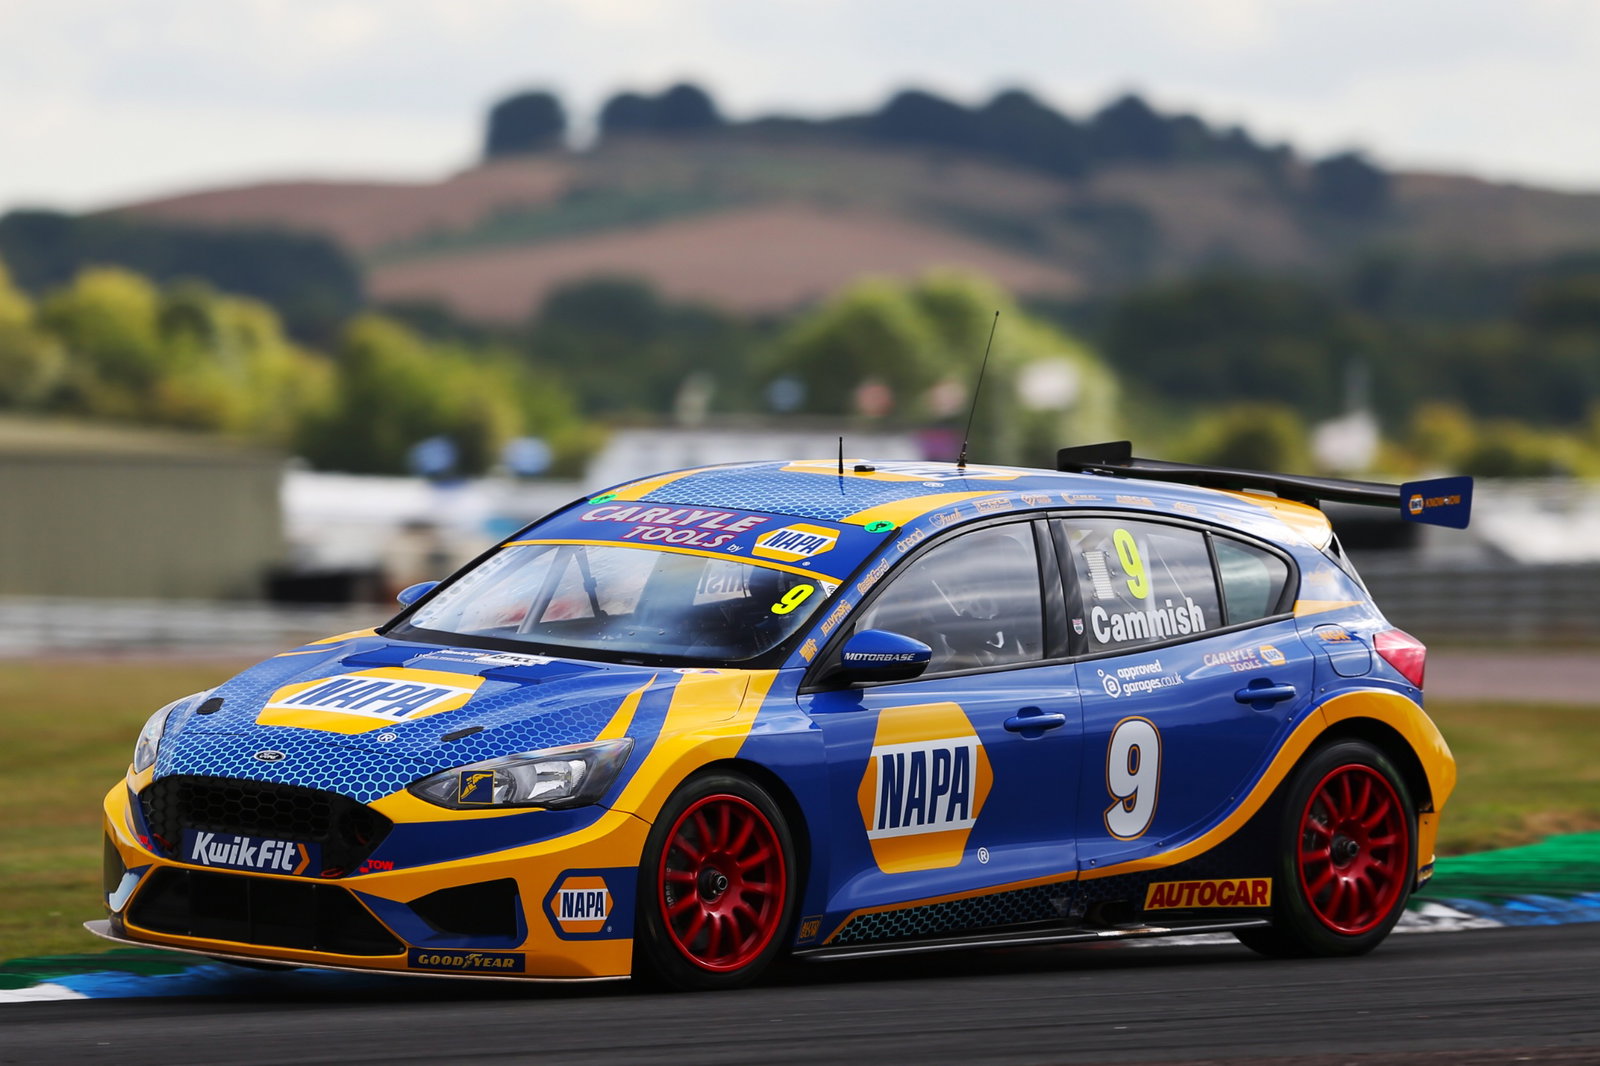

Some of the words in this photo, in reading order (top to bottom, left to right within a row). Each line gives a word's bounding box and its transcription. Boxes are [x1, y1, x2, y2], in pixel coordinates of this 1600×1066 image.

[580, 504, 770, 533] CARLYLE
[621, 524, 737, 549] TOOLS
[726, 543, 744, 553] by
[762, 530, 828, 555] NAPA
[1112, 528, 1149, 600] 9
[771, 584, 815, 615] 9
[1091, 597, 1206, 644] Cammish
[844, 652, 916, 662] MOTORBASE
[1117, 659, 1162, 680] approved
[1203, 648, 1257, 667] CARLYLE
[1230, 659, 1263, 673] TOOLS
[283, 678, 454, 717] NAPA
[1122, 672, 1185, 697] garages.co.uk
[877, 745, 970, 831] NAPA
[1103, 716, 1162, 841] 9
[366, 859, 394, 871] TOW
[562, 891, 604, 918] NAPA
[1147, 879, 1269, 909] AUTOCAR
